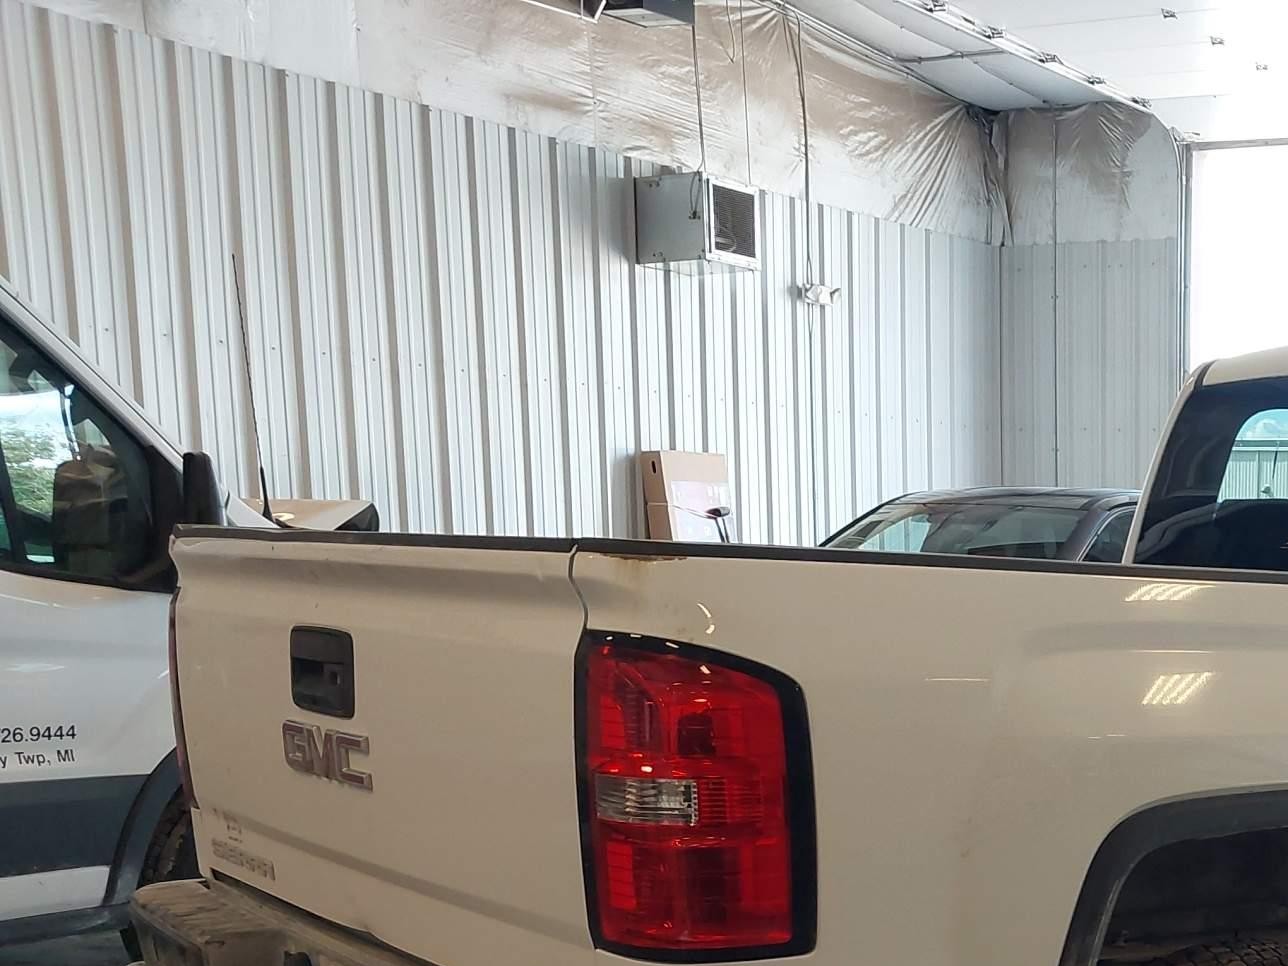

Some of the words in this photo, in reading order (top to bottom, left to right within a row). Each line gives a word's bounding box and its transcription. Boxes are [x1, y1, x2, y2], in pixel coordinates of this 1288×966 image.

[14, 751, 51, 767] Twp,
[56, 749, 76, 762] MI
[282, 719, 373, 792] GMC
